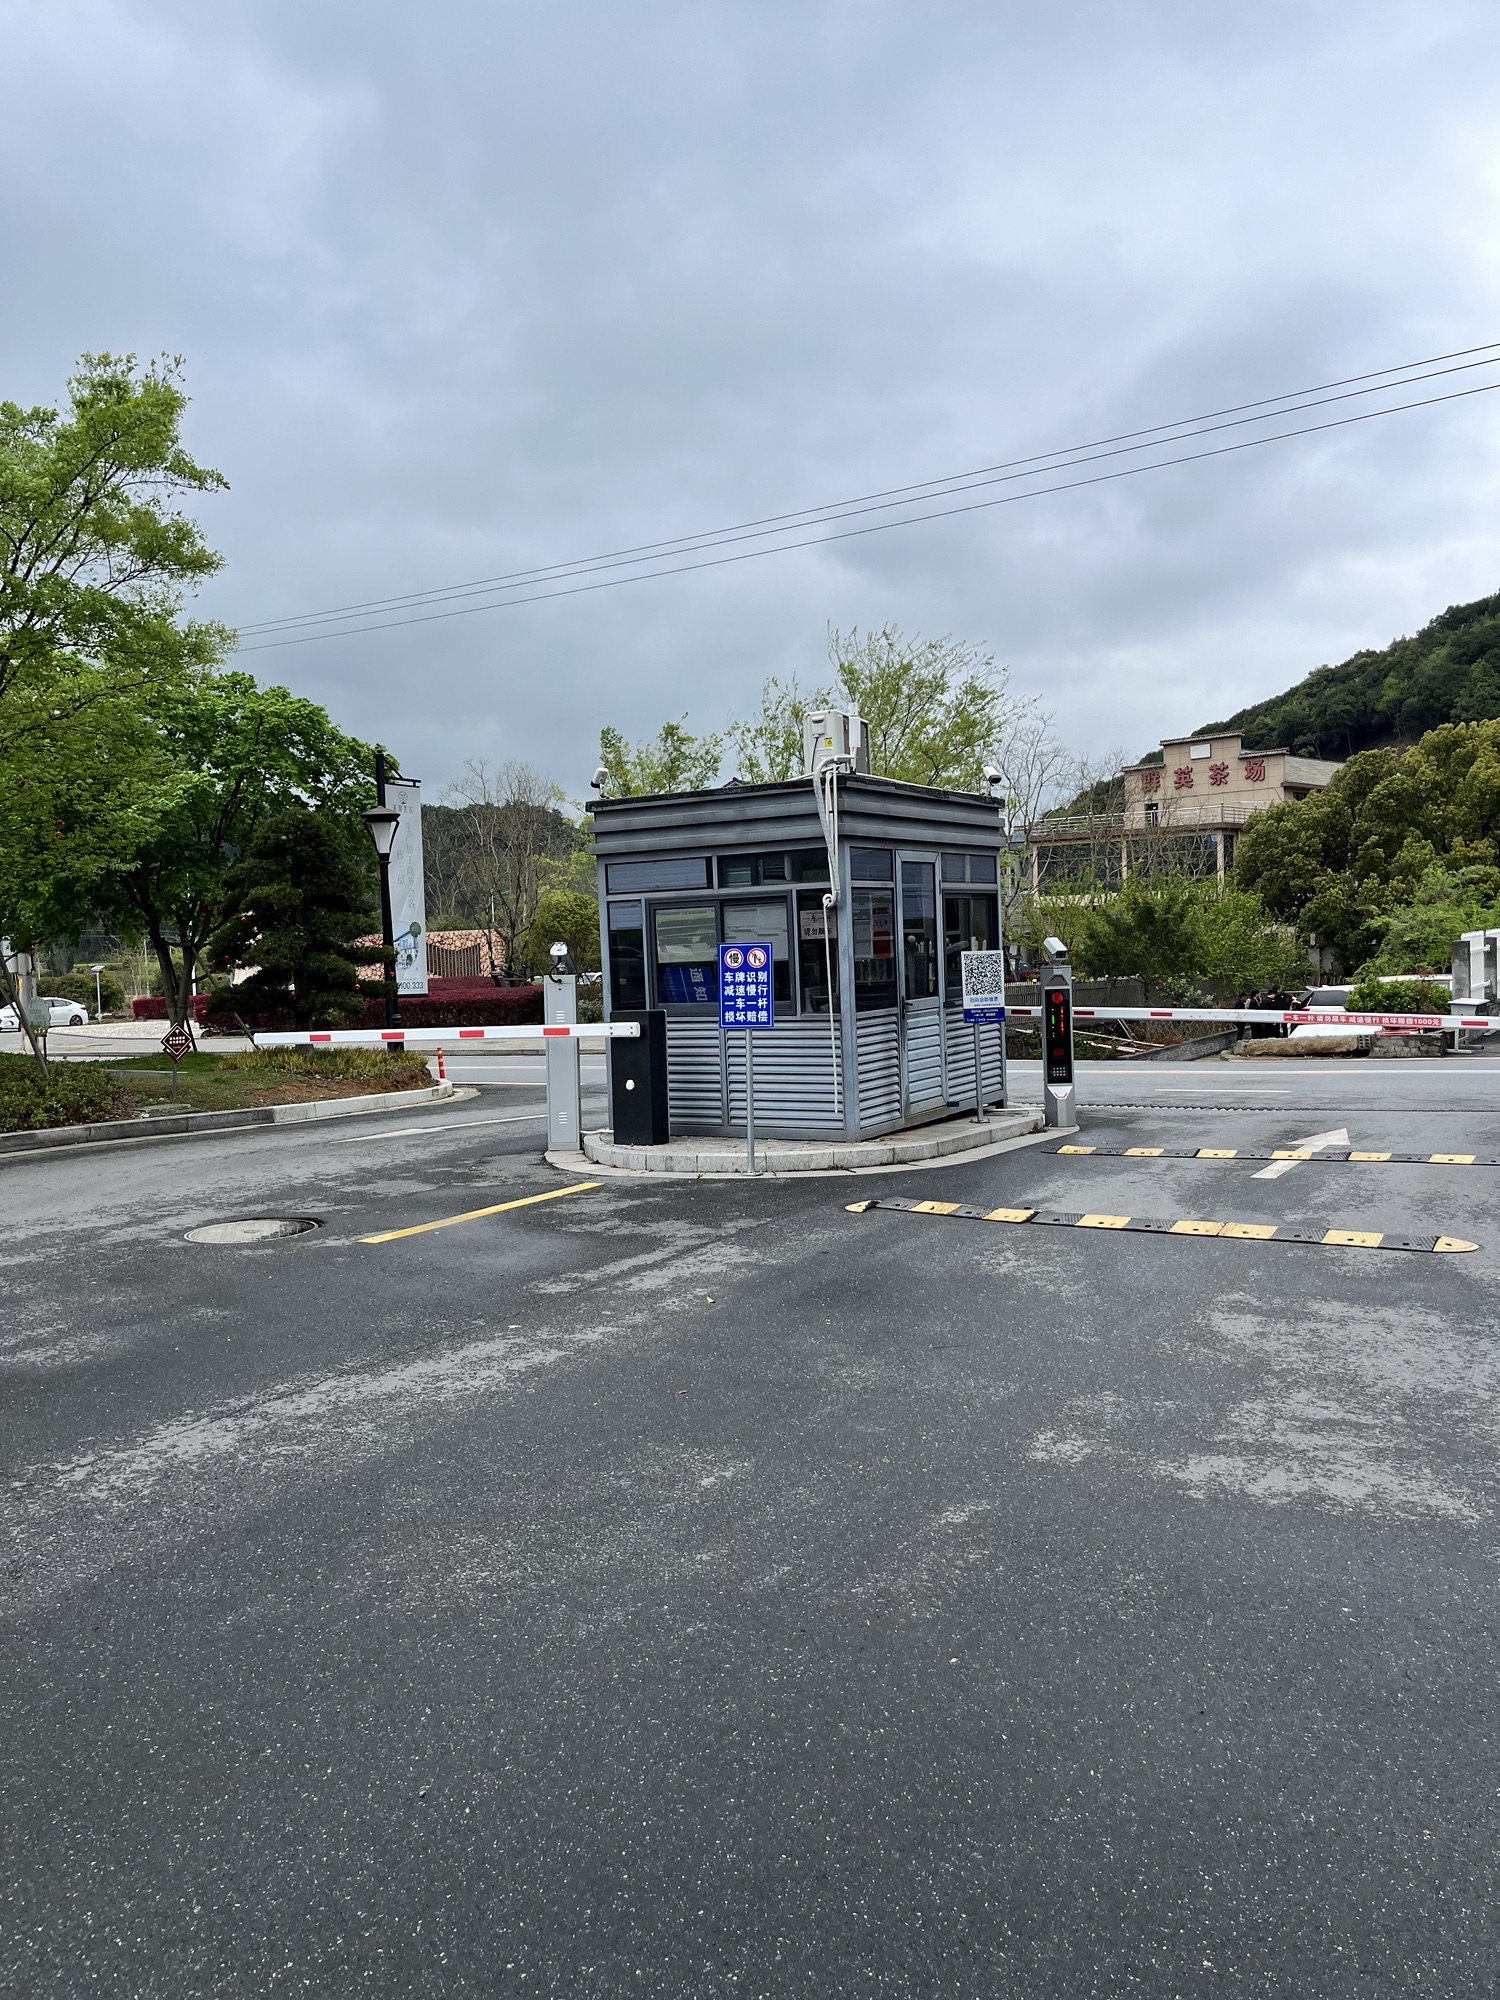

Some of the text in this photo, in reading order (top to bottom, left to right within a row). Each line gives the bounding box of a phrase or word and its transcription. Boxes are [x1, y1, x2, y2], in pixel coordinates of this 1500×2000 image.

[1141, 760, 1265, 793] 群英茶场
[724, 971, 768, 983] 车牌识别
[412, 981, 424, 990] 333
[724, 984, 768, 997] 减速慢行
[724, 997, 768, 1010] 一车一杆
[724, 1010, 768, 1023] 损坏赔偿
[1285, 1014, 1440, 1026] 一车一杆 请勿跟车 减速慢行 损坏赔偿1000元
